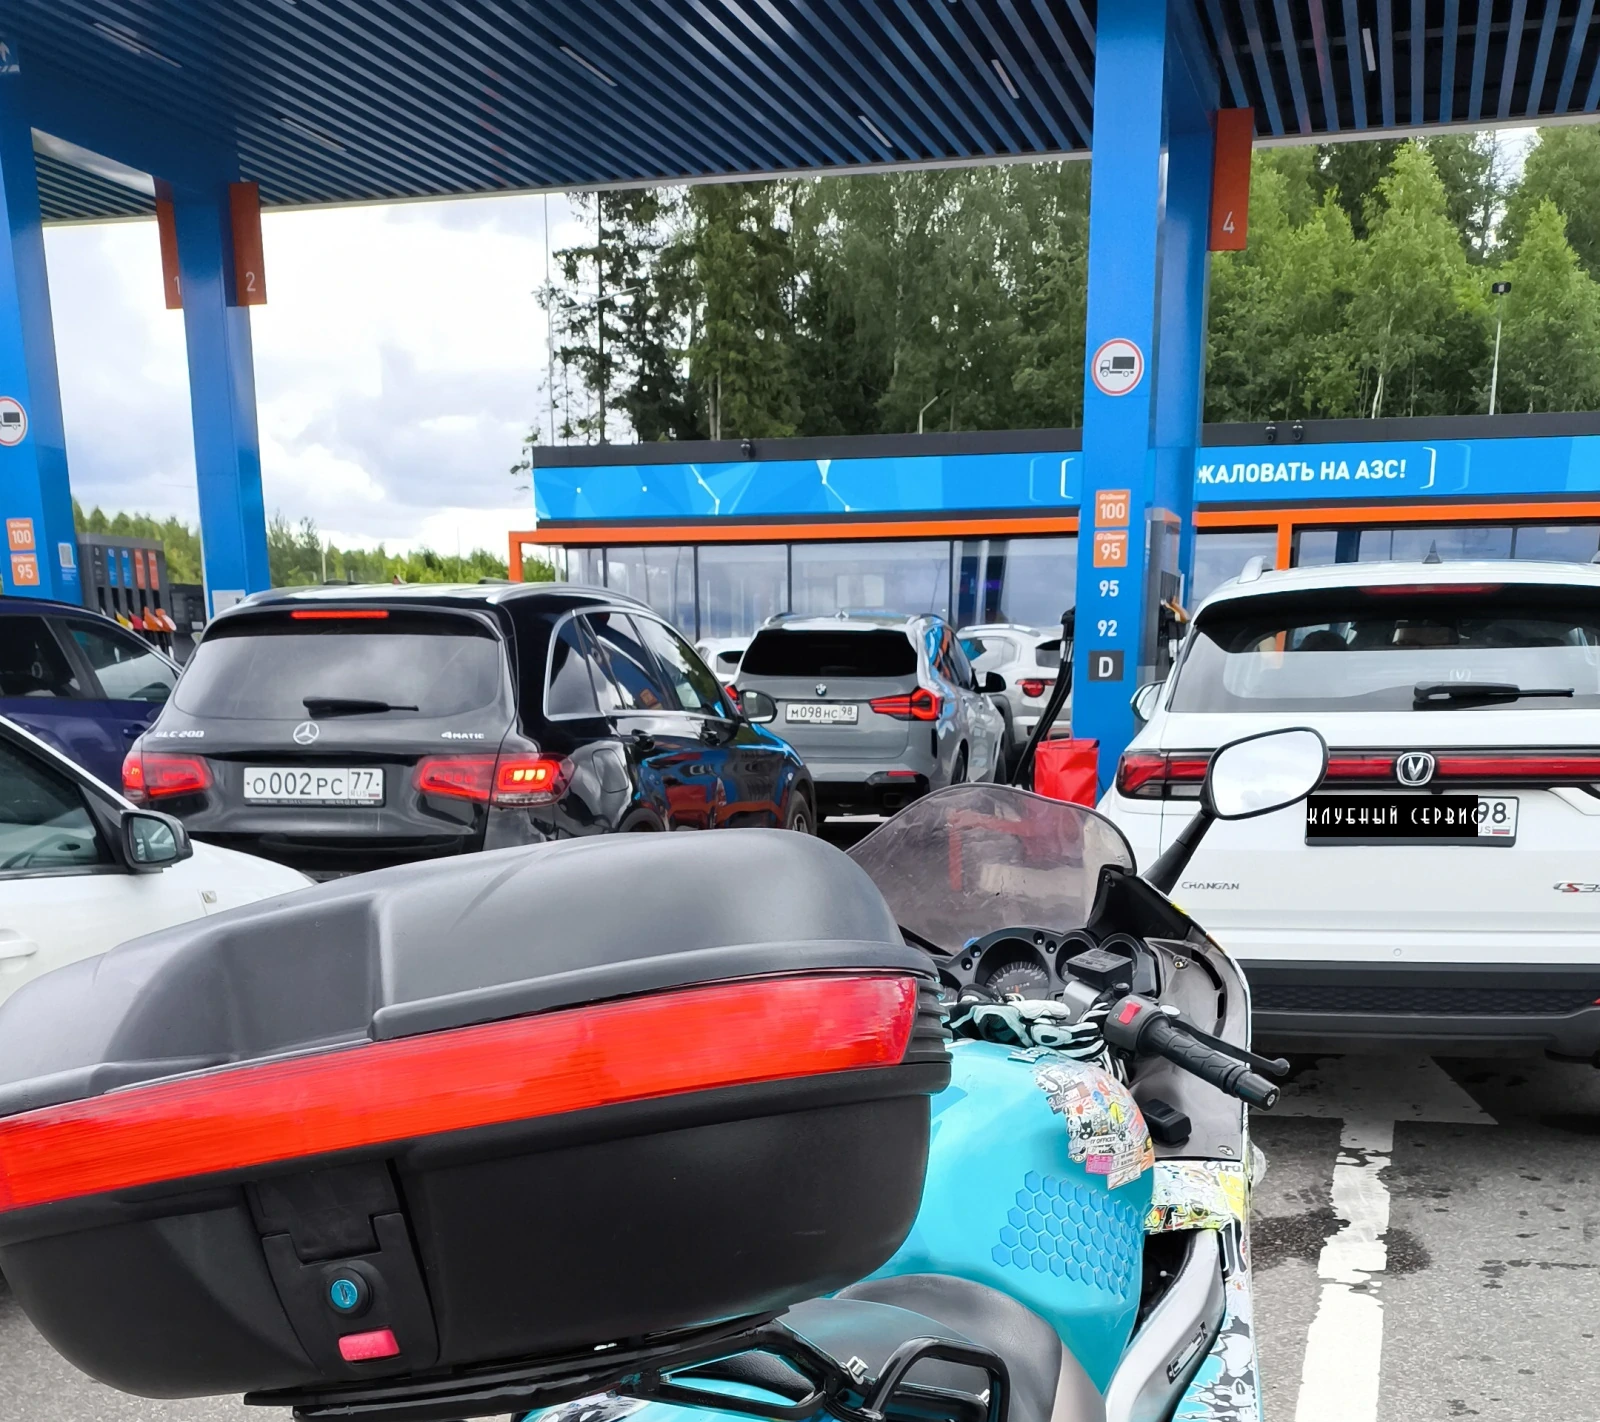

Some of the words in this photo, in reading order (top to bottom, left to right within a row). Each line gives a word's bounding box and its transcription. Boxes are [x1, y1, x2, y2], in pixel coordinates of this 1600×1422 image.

[1223, 211, 1235, 234] 4
[173, 275, 181, 295] 1
[245, 271, 257, 292] 2
[1320, 461, 1350, 480] НА
[1355, 459, 1407, 479] АЗС!
[1100, 502, 1125, 519] 100
[12, 530, 32, 544] 100
[1101, 543, 1120, 560] 95
[17, 564, 34, 579] 95
[1099, 580, 1120, 598] 95
[1097, 620, 1118, 638] 92
[1098, 656, 1114, 678] D
[178, 730, 205, 738] 200
[351, 771, 374, 790] 77
[1478, 801, 1507, 824] 98
[1181, 881, 1240, 890] CHANGAN
